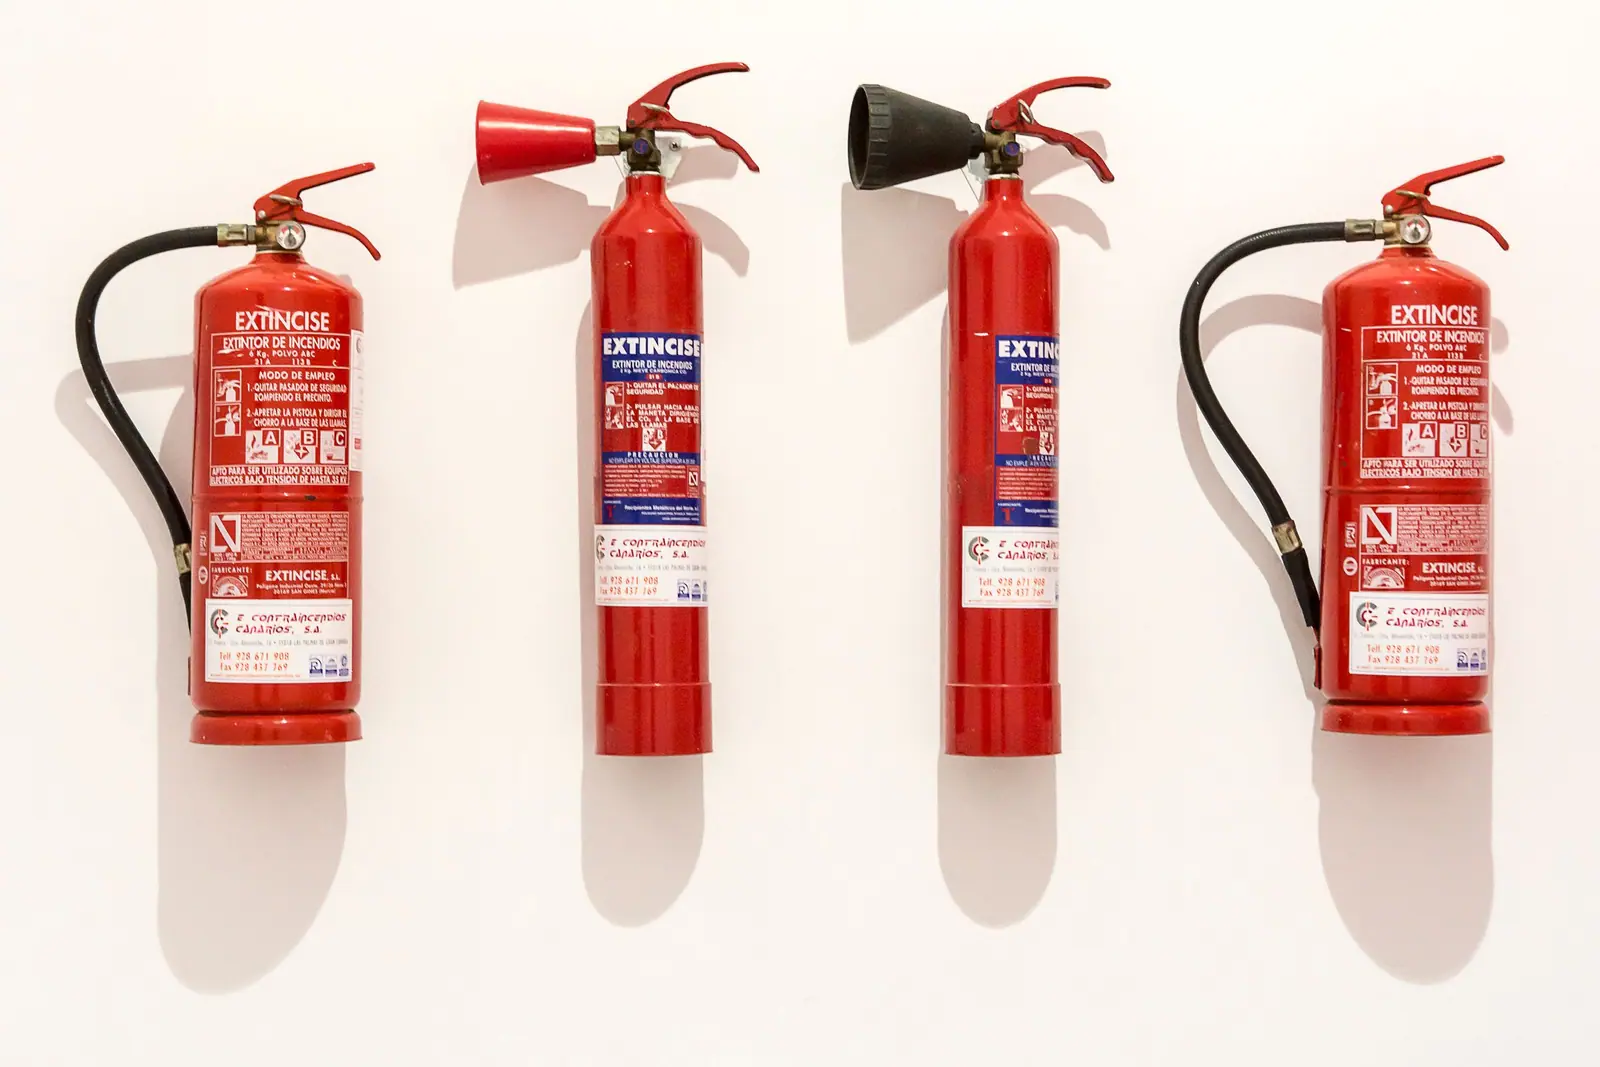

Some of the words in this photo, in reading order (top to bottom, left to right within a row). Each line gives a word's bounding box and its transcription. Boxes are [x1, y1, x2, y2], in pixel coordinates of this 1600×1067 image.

[1391, 305, 1478, 326] EXTINCISE
[236, 311, 329, 331] EXTINCISE
[1377, 330, 1426, 343] EXTINTOR
[1430, 331, 1442, 343] DE
[1445, 331, 1484, 344] INCENDIOS
[223, 337, 269, 349] EXTINTOR
[273, 337, 285, 349] DE
[289, 337, 340, 350] INCENDIOS
[604, 337, 700, 357] EXTINCISE
[612, 360, 645, 369] EXTINTOR
[658, 361, 692, 370] INCENDIOS
[1011, 363, 1042, 372] EXTINTOR
[1044, 364, 1051, 372] DE
[1416, 365, 1444, 373] MODO
[1446, 365, 1457, 373] DE
[1458, 365, 1481, 374] EMPLEO
[259, 371, 288, 379] MODO
[292, 371, 303, 379] DE
[306, 372, 335, 380] EMPLEO
[280, 384, 308, 392] PASADOR
[311, 384, 318, 392] DE
[1411, 386, 1448, 396] ROMPIENDO
[254, 393, 293, 402] ROMPIENDO
[295, 393, 302, 401] EL
[1439, 402, 1446, 410] LA
[283, 409, 291, 417] LA
[293, 409, 317, 417] PISTOLA
[1411, 412, 1436, 420] CHORRO
[254, 419, 279, 427] CHORRO
[295, 419, 310, 427] BASE
[311, 419, 318, 427] DE
[319, 419, 329, 427] LAS
[1422, 424, 1434, 438] A
[1457, 425, 1466, 437] B
[265, 431, 276, 444] A
[303, 431, 314, 445] B
[335, 432, 344, 445] C
[1363, 460, 1382, 468] APTO
[1405, 460, 1417, 468] SER
[1419, 460, 1454, 468] UTILIZADO
[212, 467, 227, 476] APTO
[229, 467, 245, 475] PARA
[248, 467, 260, 475] SER
[262, 467, 299, 475] UTILIZADO
[302, 467, 323, 475] SOBRE
[325, 467, 347, 475] EQUIPOS
[1402, 469, 1421, 477] BAJO
[1423, 469, 1452, 477] TENSION
[245, 476, 264, 484] BAJO
[311, 476, 331, 484] HASTA
[1386, 645, 1401, 653] 928
[236, 652, 250, 660] 928
[255, 652, 268, 660] 671
[274, 652, 289, 660] 908
[1385, 655, 1400, 663] 928
[235, 663, 249, 671] 928
